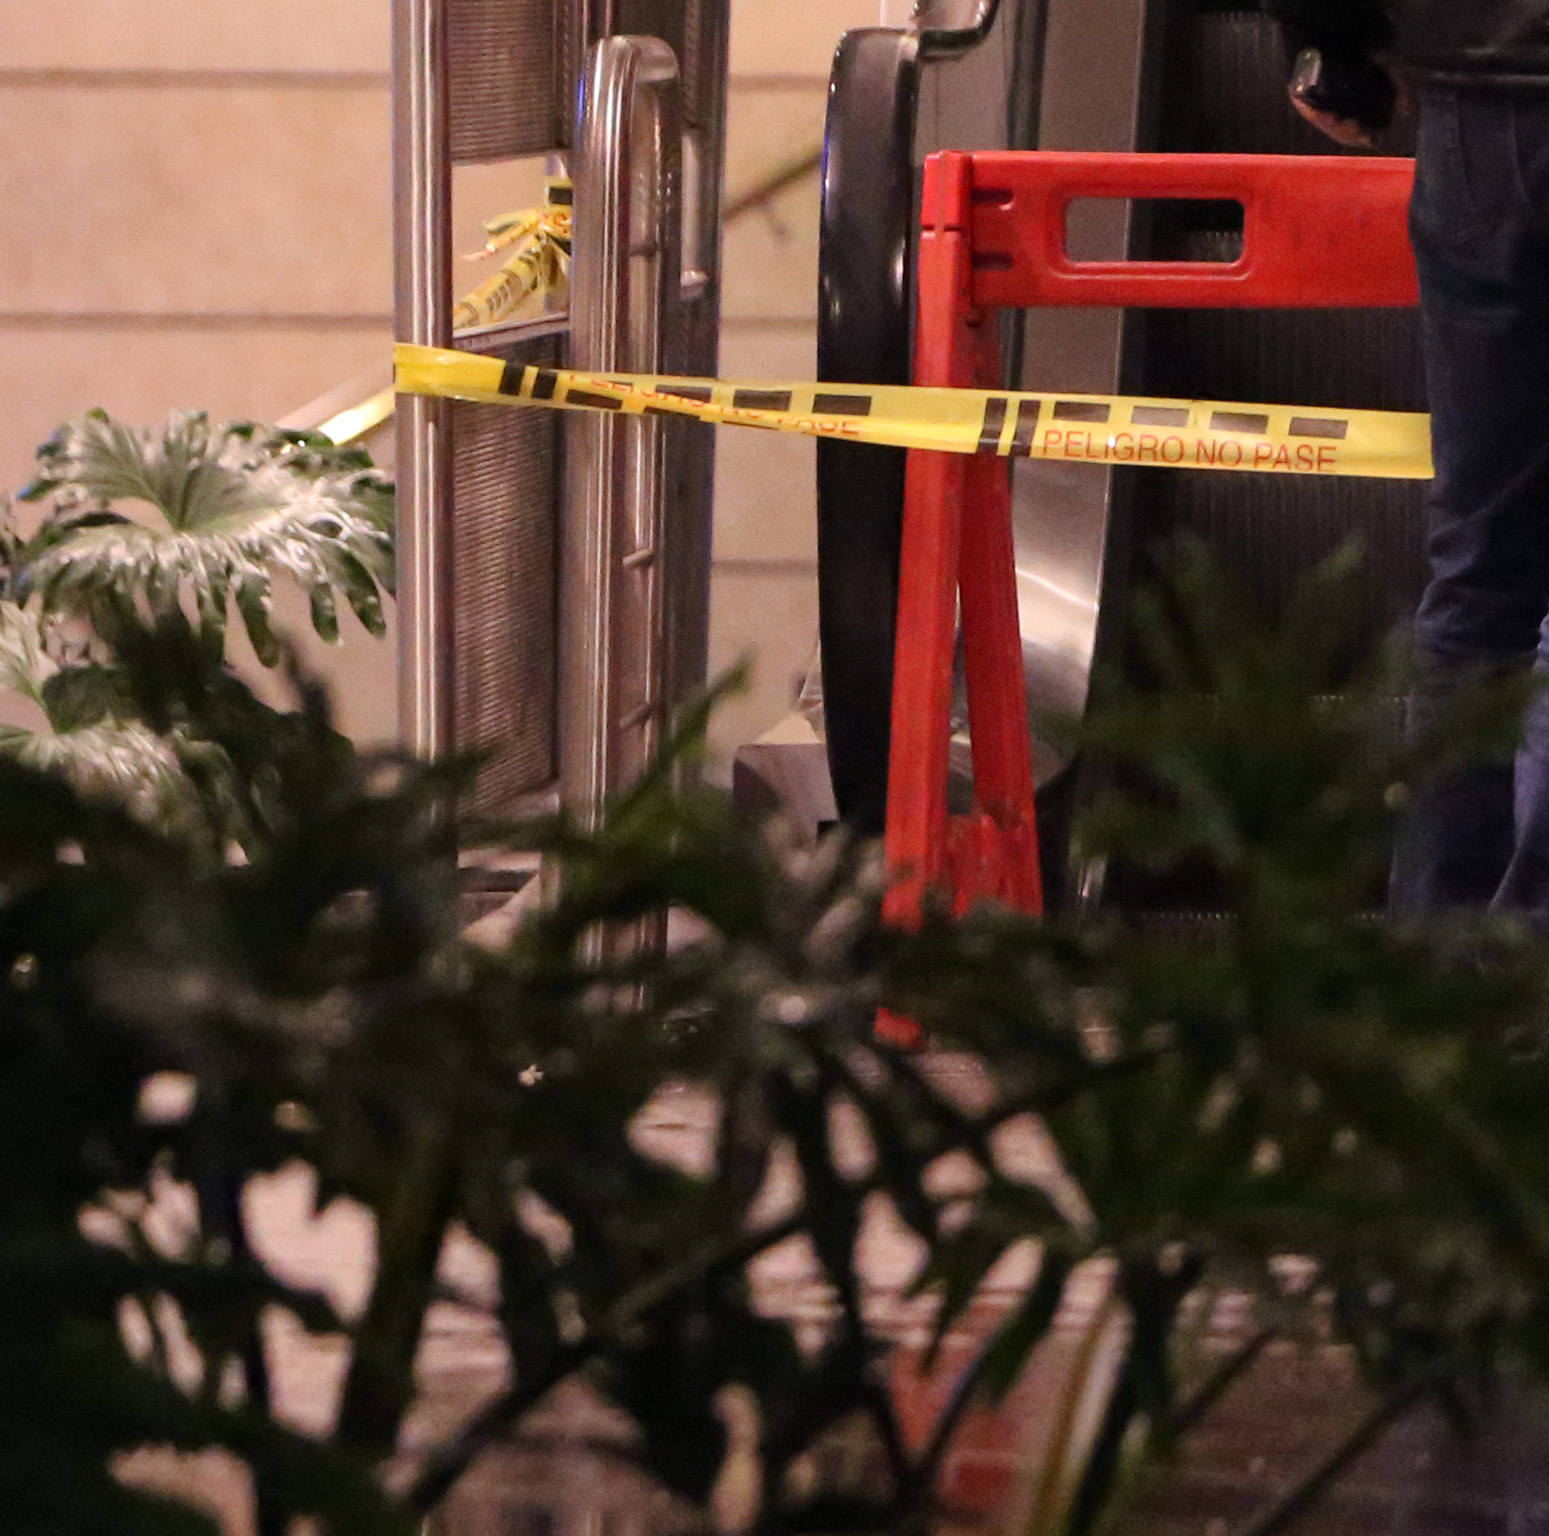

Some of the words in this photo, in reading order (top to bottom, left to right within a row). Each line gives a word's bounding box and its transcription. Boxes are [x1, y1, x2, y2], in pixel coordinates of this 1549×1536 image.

[1042, 428, 1187, 463] PELIGRO
[1195, 437, 1242, 468] NO
[1253, 442, 1337, 473] PASE
